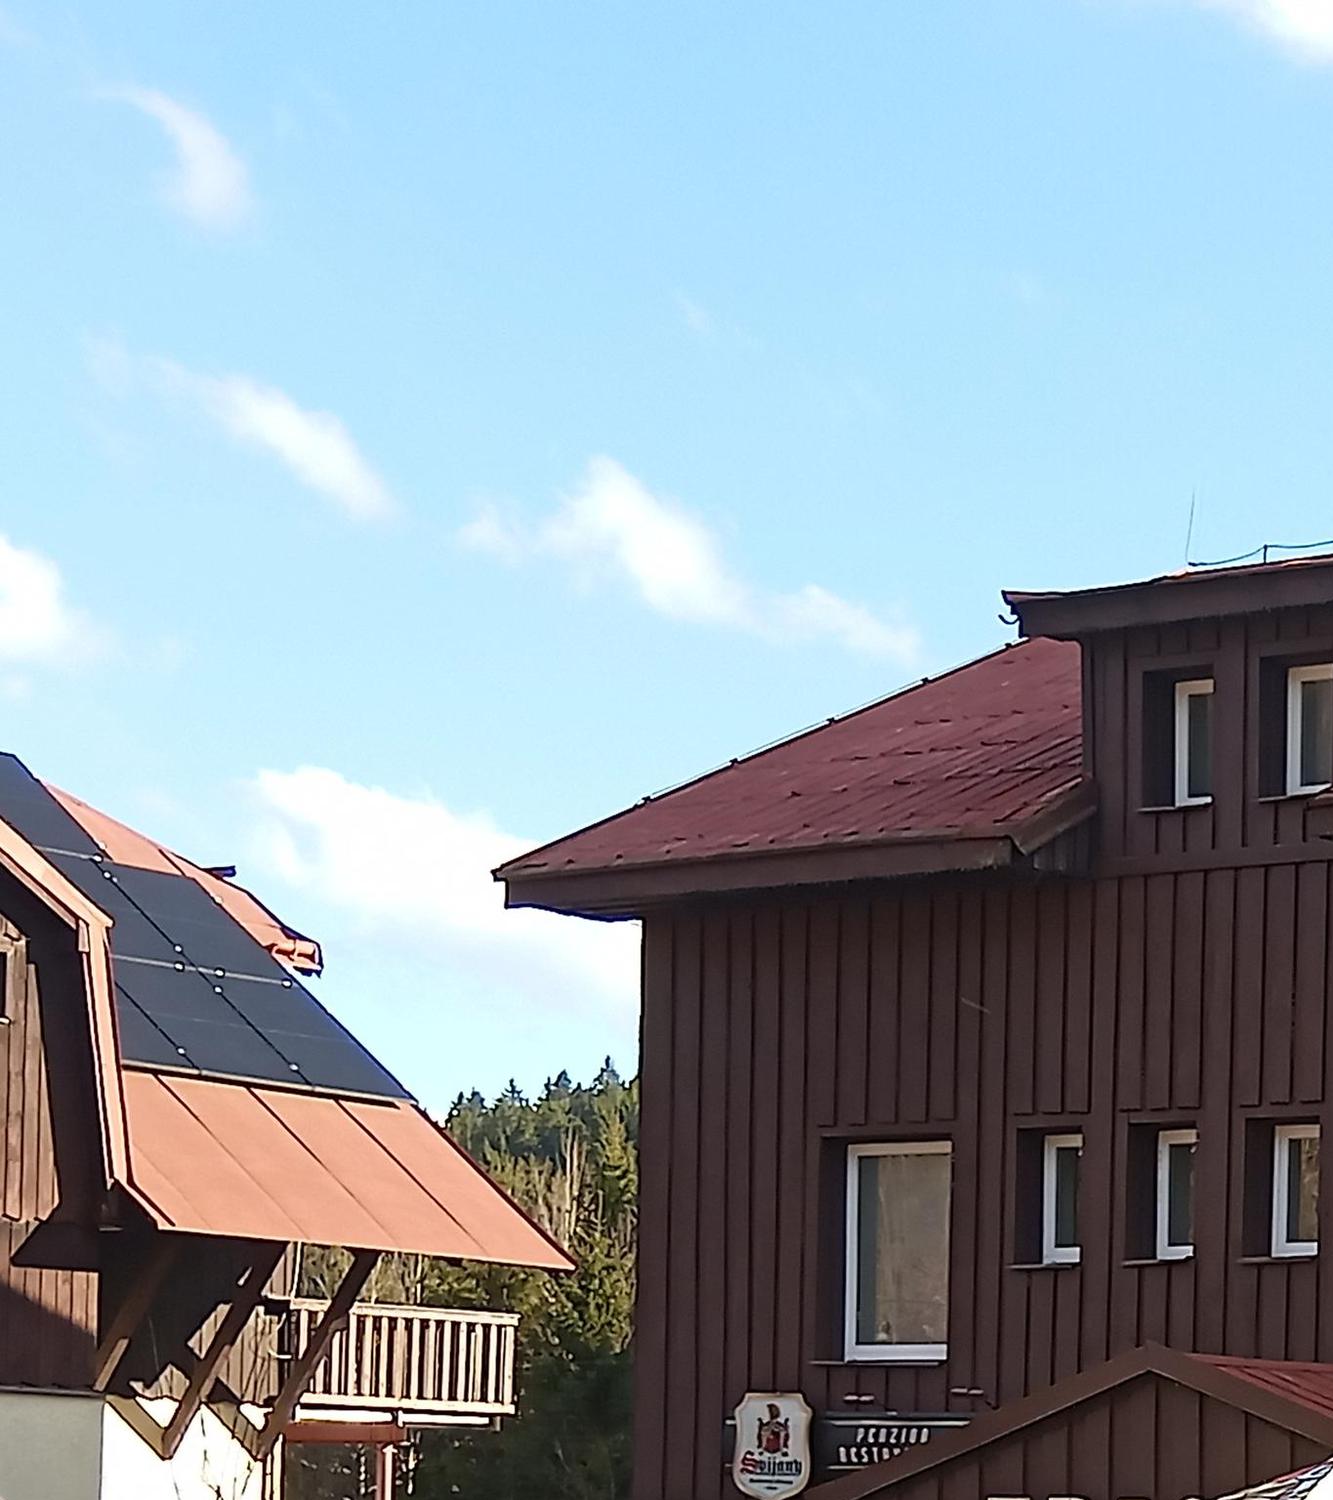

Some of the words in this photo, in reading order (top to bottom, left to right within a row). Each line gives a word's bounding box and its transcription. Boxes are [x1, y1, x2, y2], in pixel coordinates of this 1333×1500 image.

[855, 1427, 930, 1444] PENZION
[739, 1450, 802, 1476] Svijany
[838, 1447, 910, 1463] RESTA
